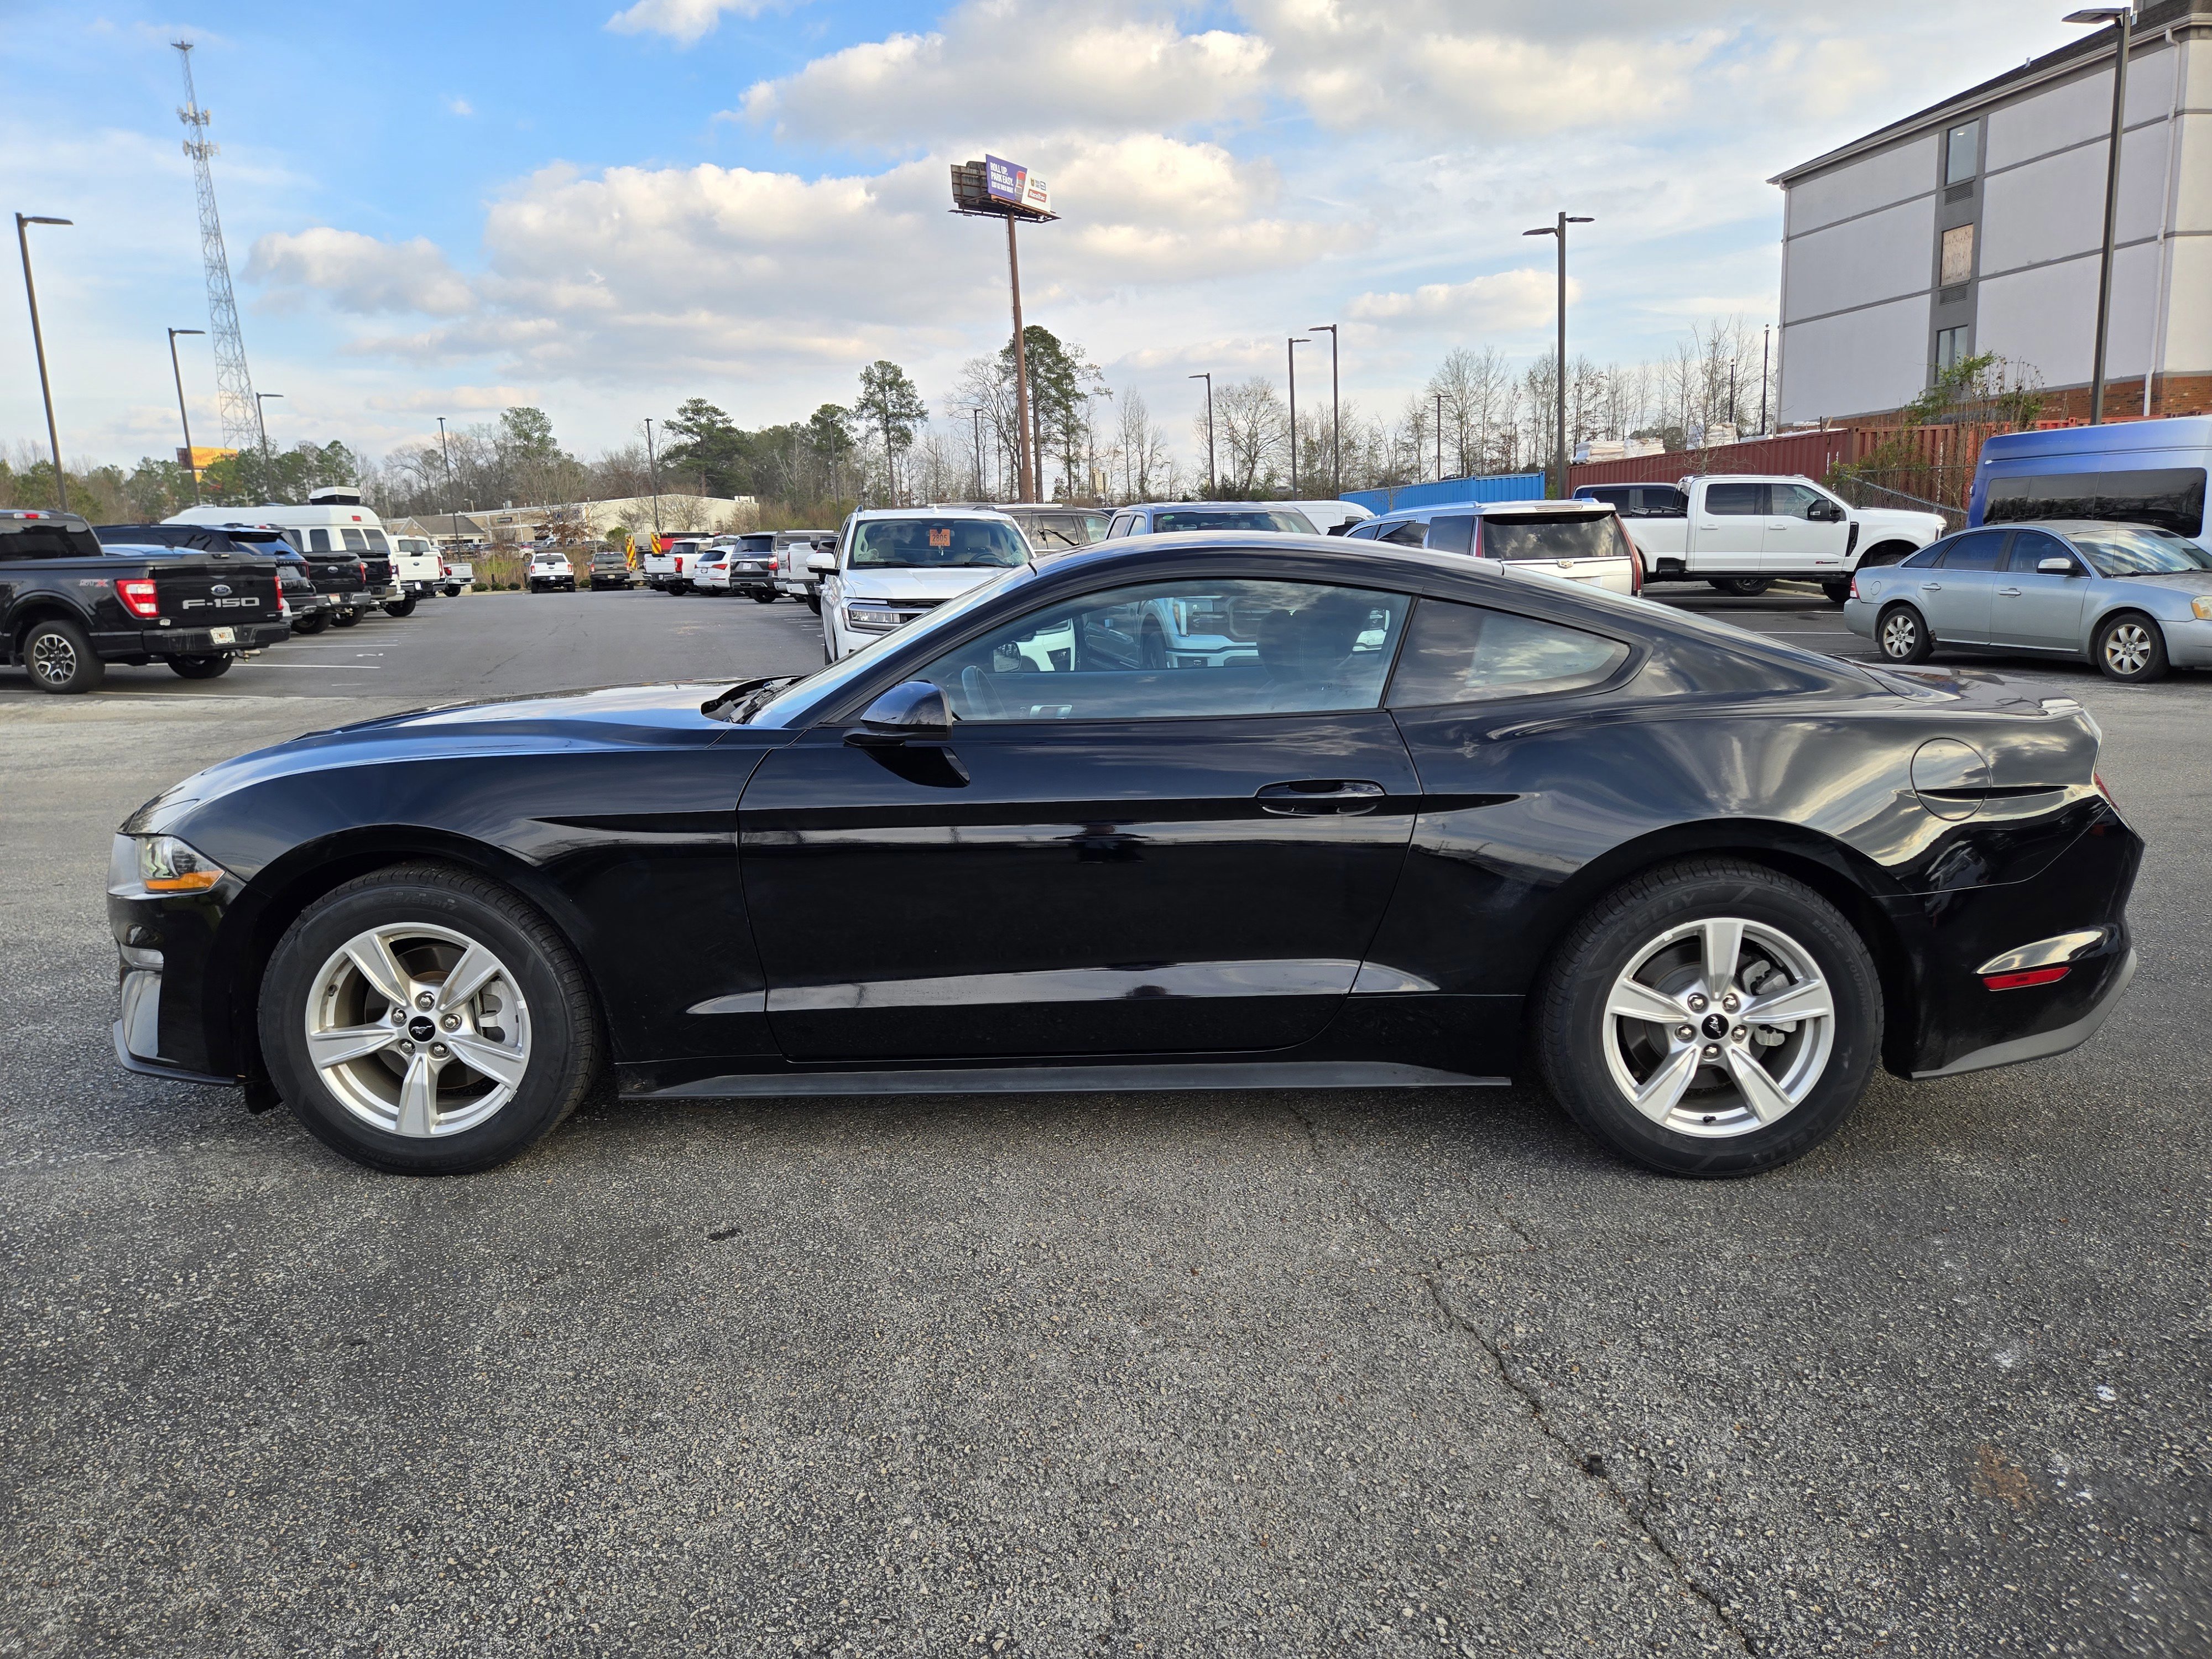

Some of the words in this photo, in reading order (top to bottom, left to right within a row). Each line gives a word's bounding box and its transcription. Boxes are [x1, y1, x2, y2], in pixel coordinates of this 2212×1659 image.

[990, 161, 1001, 174] ROLL
[990, 171, 1003, 183] PARK
[1002, 175, 1014, 187] EASY.
[182, 597, 260, 609] F-150
[1619, 893, 1696, 943] KELLY
[1811, 919, 1844, 950] EDGE
[1846, 955, 1869, 1016] TOURING
